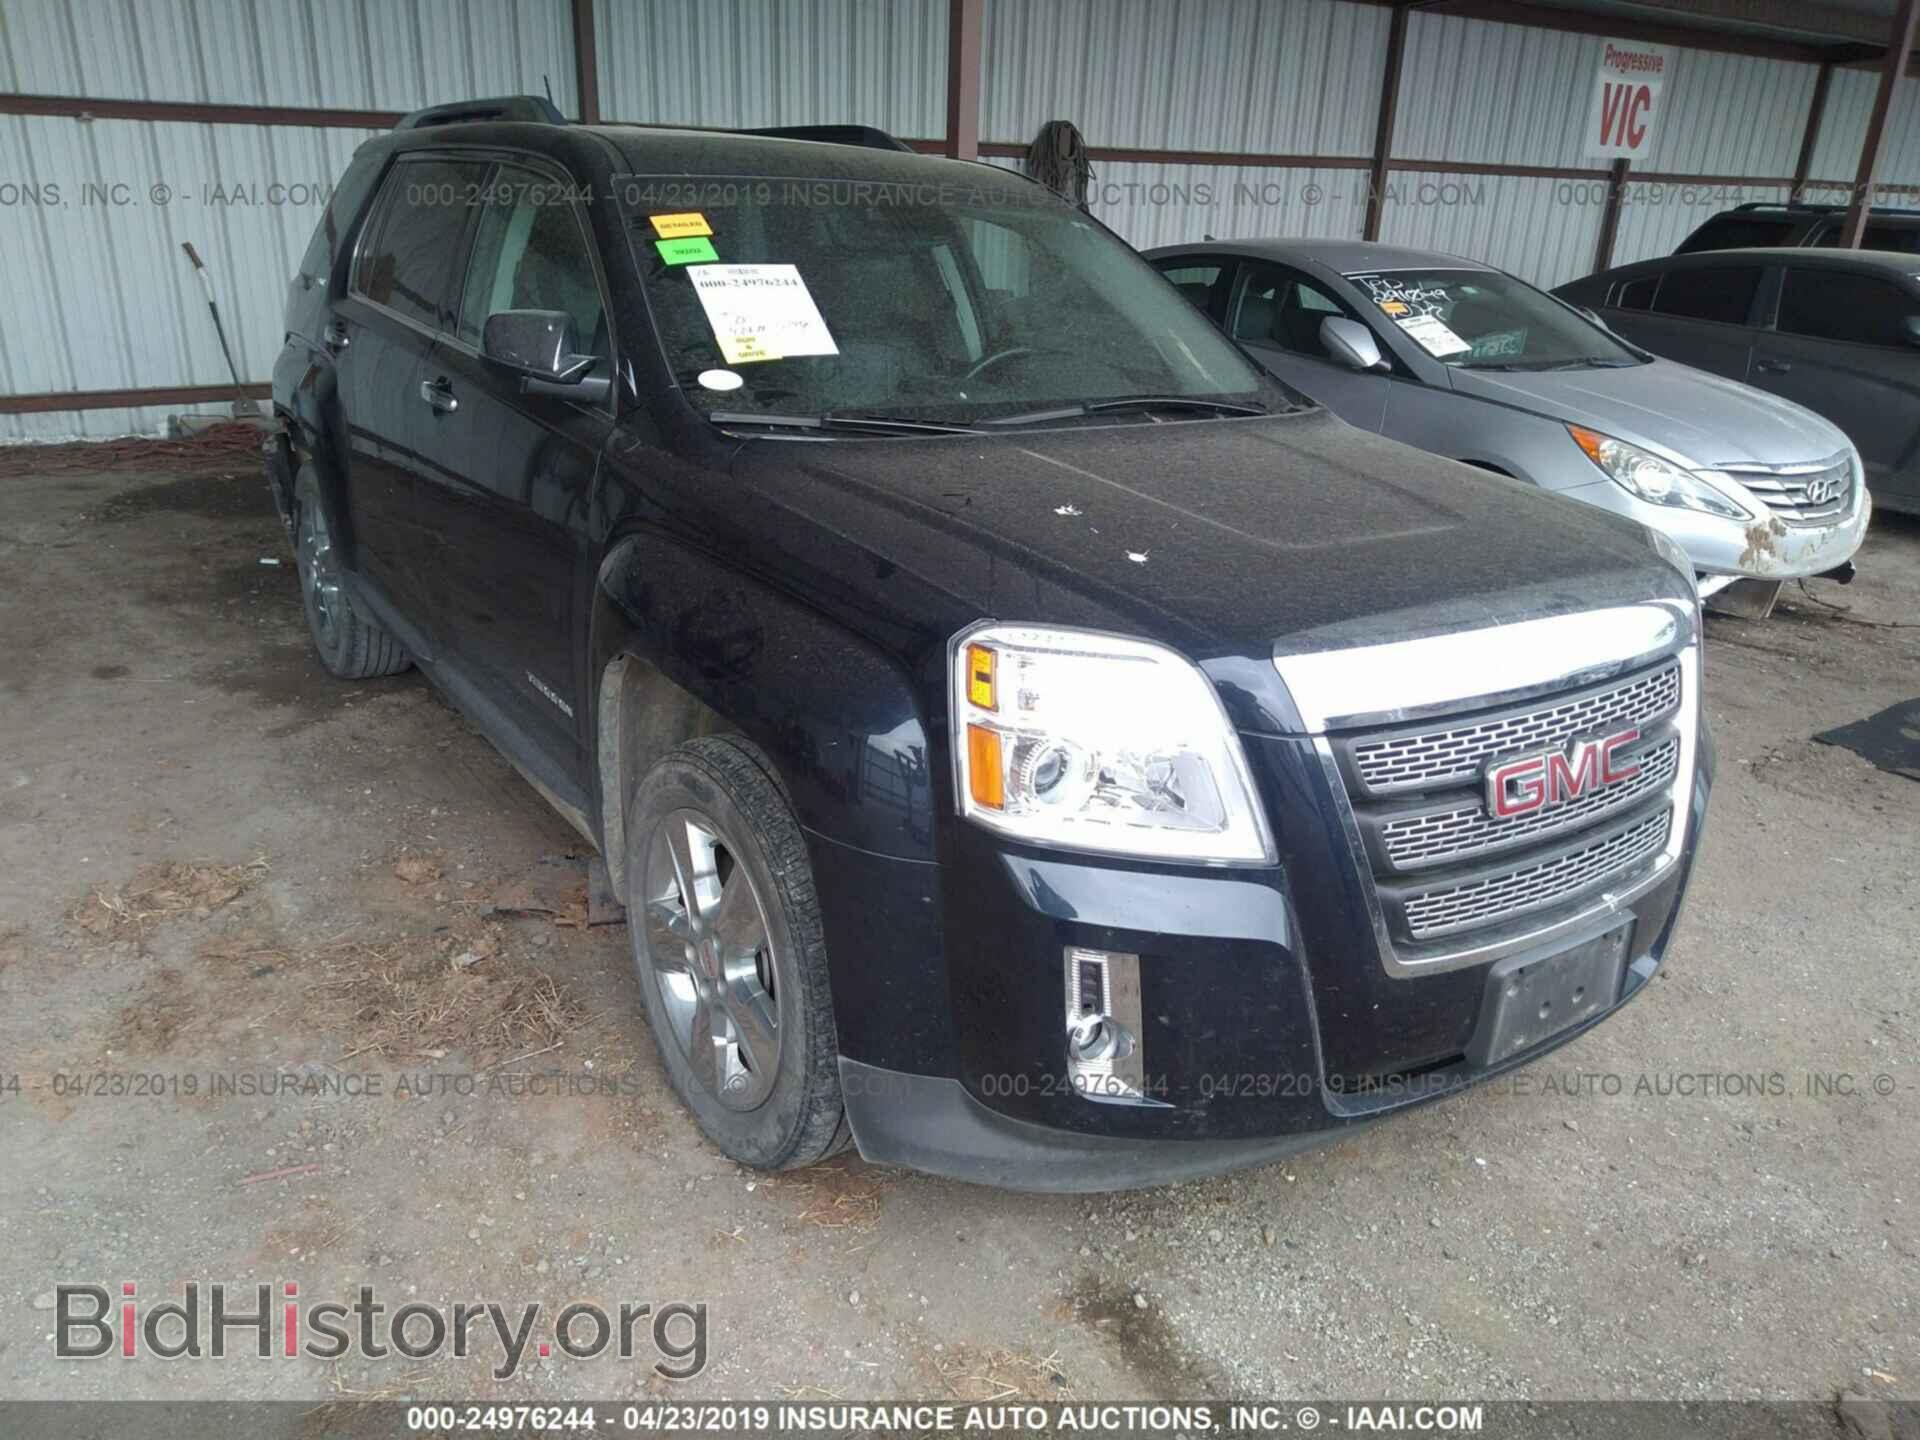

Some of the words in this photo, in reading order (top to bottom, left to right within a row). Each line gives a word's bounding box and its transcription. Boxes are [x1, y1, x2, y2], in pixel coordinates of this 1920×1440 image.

[1603, 43, 1664, 74] Progressive
[1600, 82, 1651, 149] VIC
[700, 278, 799, 289] 000-24976244
[1491, 727, 1641, 820] GMC
